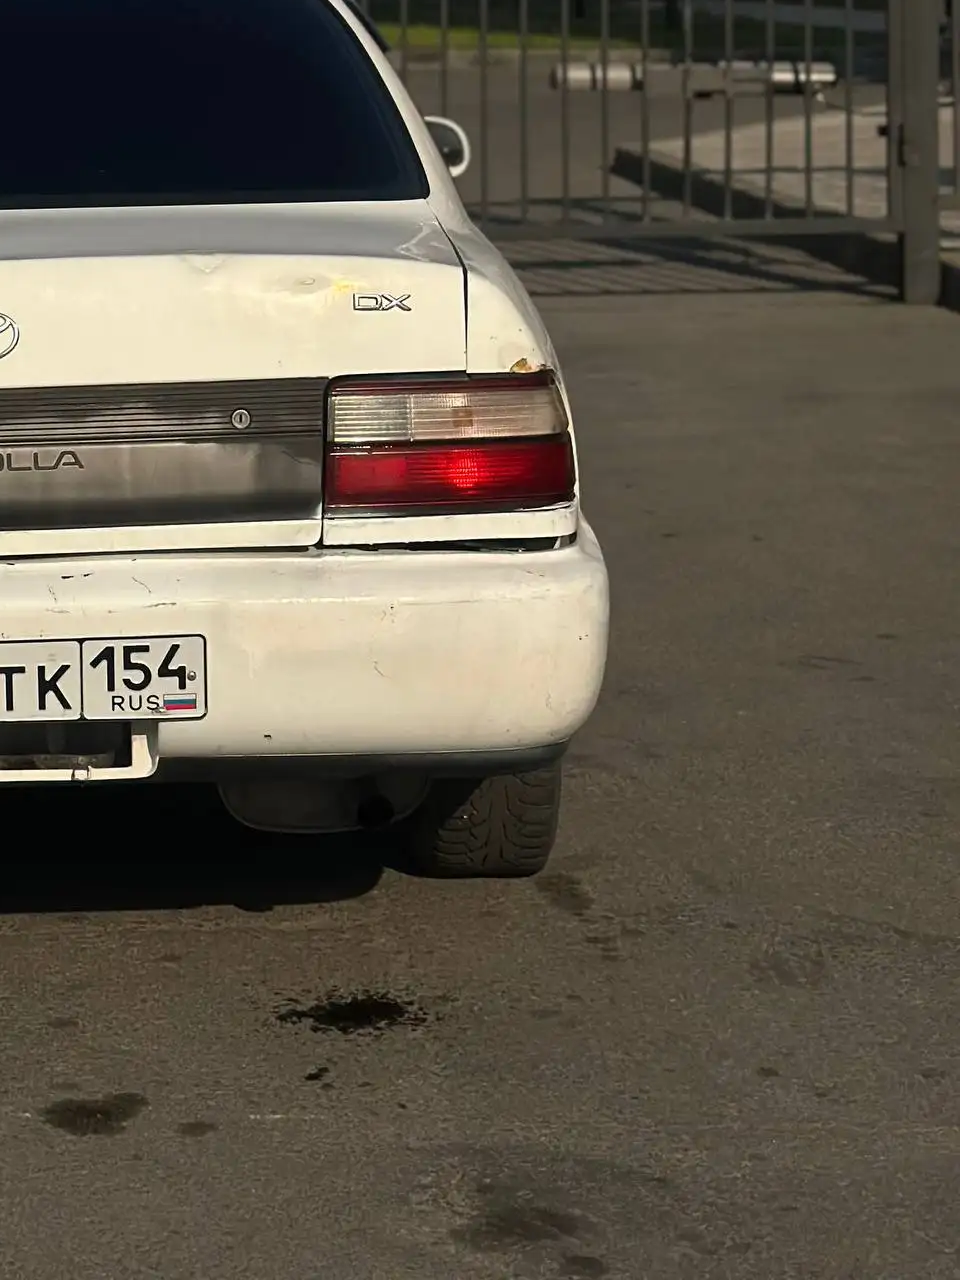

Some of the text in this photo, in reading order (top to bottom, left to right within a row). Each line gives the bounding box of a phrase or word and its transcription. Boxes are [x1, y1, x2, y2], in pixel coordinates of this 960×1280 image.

[352, 292, 412, 311] DX
[89, 643, 188, 692] 154
[111, 693, 160, 712] RUS
